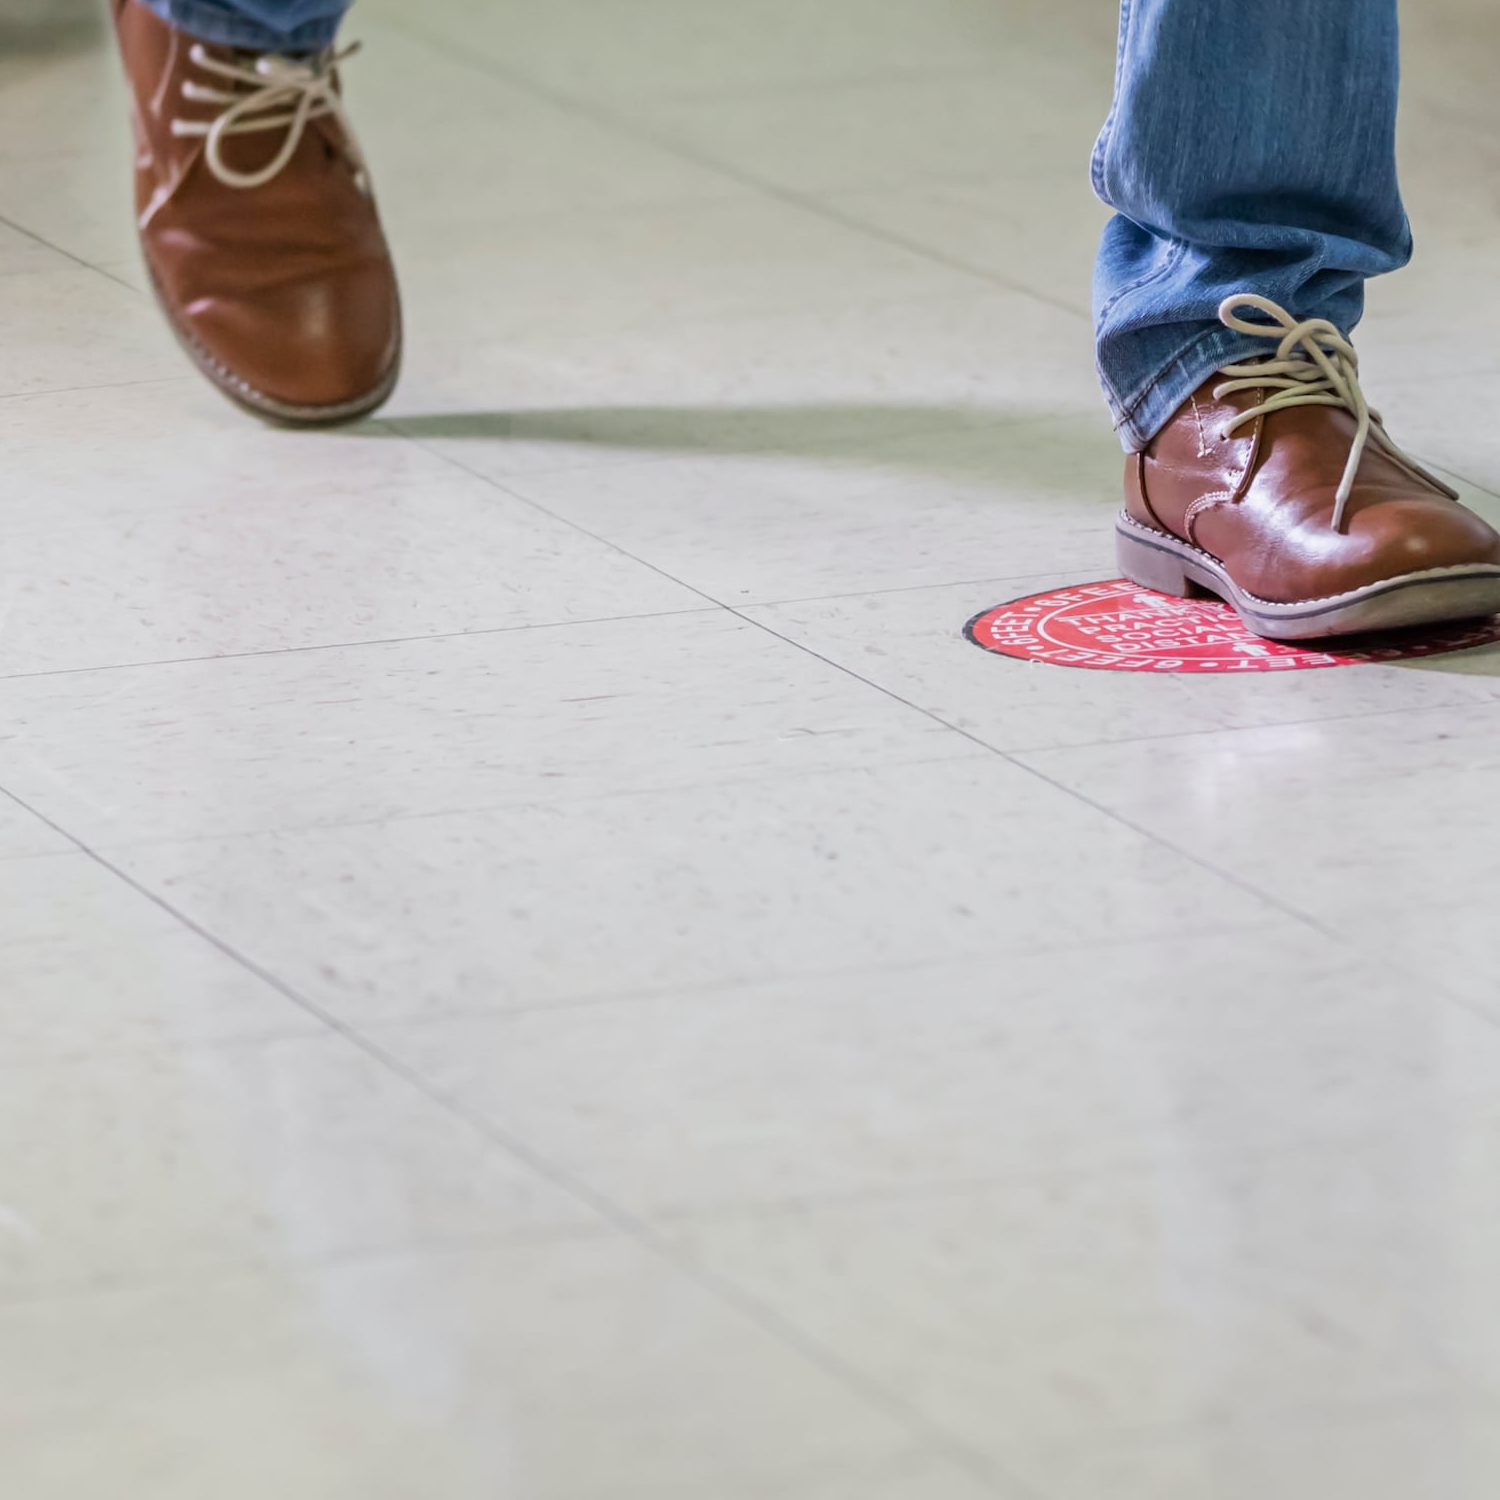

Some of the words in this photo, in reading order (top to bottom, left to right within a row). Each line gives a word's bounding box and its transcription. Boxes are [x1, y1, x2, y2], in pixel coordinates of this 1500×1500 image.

[1034, 581, 1146, 607] 6FEE
[990, 611, 1039, 645] 6FEET
[1078, 612, 1240, 635] PRACTIC
[1096, 624, 1241, 643] SOCIAL
[1111, 632, 1255, 651] DISTAN
